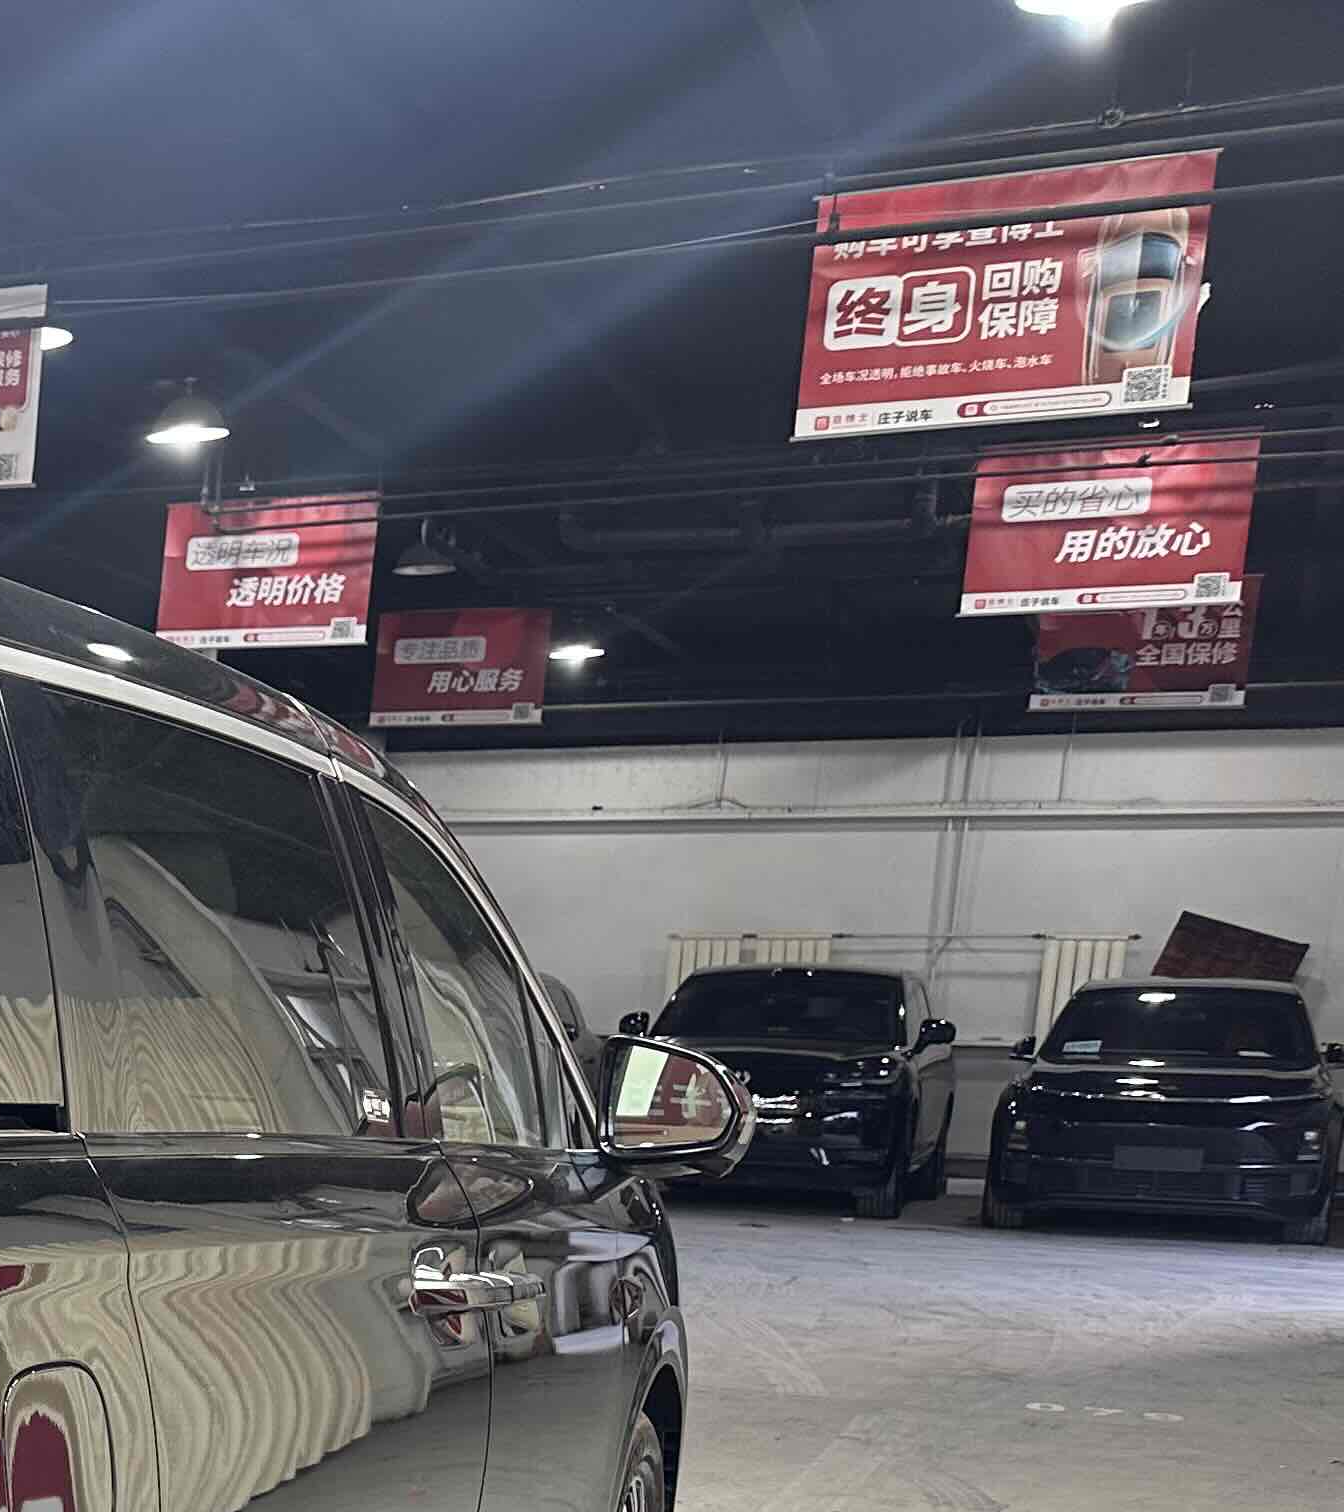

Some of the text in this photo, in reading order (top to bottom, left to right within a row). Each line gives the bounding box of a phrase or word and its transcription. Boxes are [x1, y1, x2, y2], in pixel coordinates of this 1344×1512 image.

[982, 257, 1064, 300] 回购
[833, 281, 961, 339] 终身
[978, 298, 1059, 340] 保障
[876, 409, 933, 425] 庄子说车
[1008, 485, 1140, 518] 买的省心
[1054, 522, 1211, 563] 用的放心
[226, 573, 346, 607] 透明价格
[1136, 641, 1240, 666] 全国保修
[427, 668, 525, 693] 用心服务
